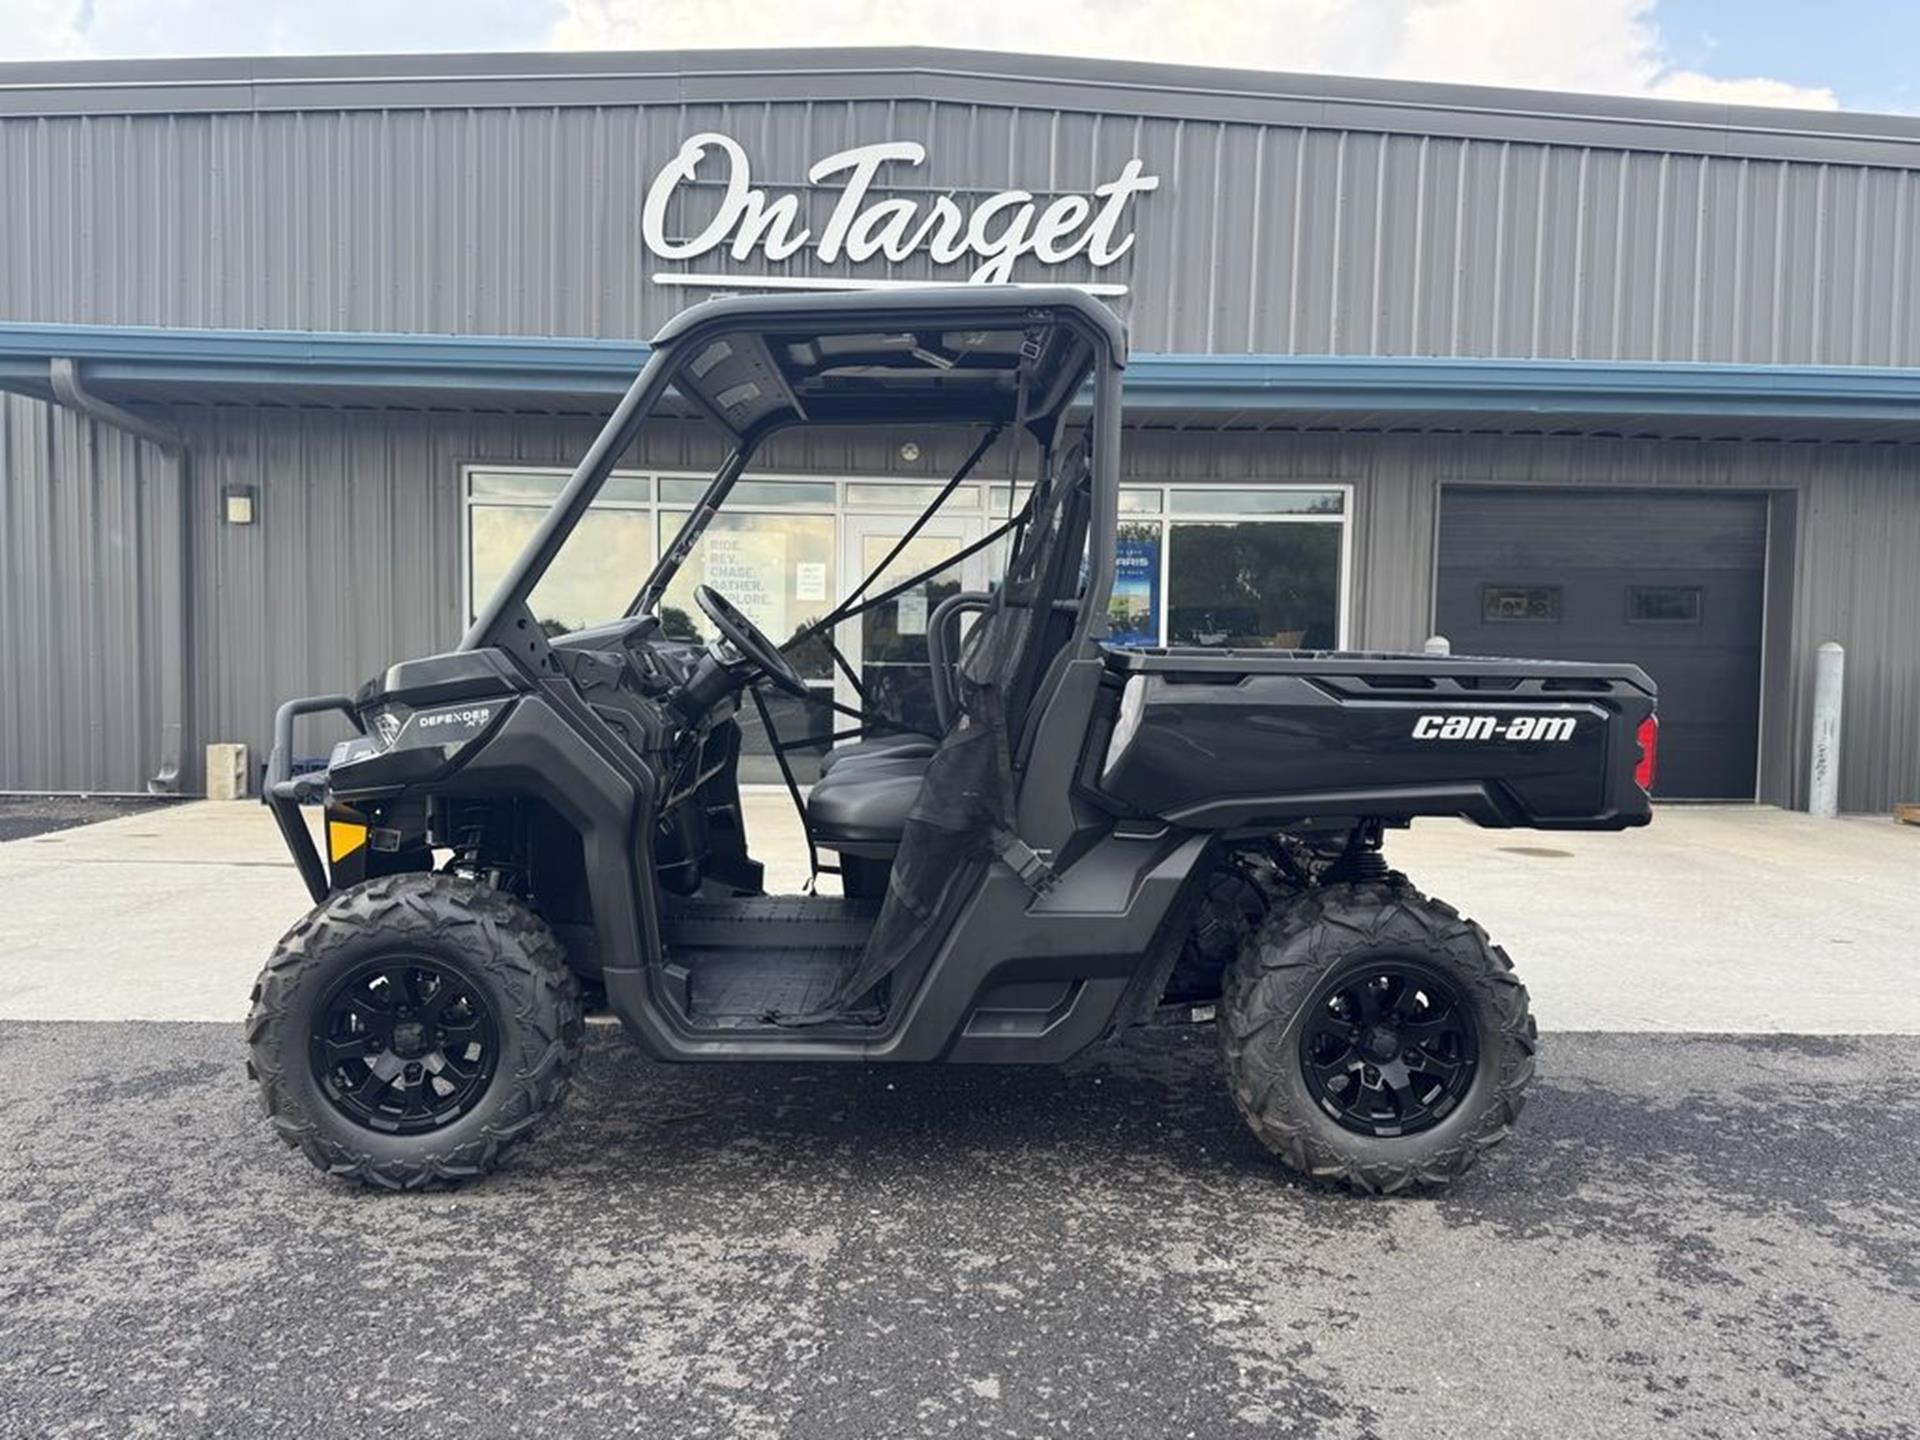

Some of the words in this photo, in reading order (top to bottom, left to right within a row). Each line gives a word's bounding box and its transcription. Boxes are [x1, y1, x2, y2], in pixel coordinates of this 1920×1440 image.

[1115, 557, 1149, 567] ARIS
[419, 708, 490, 728] DEFENDER
[1411, 715, 1577, 741] can-am
